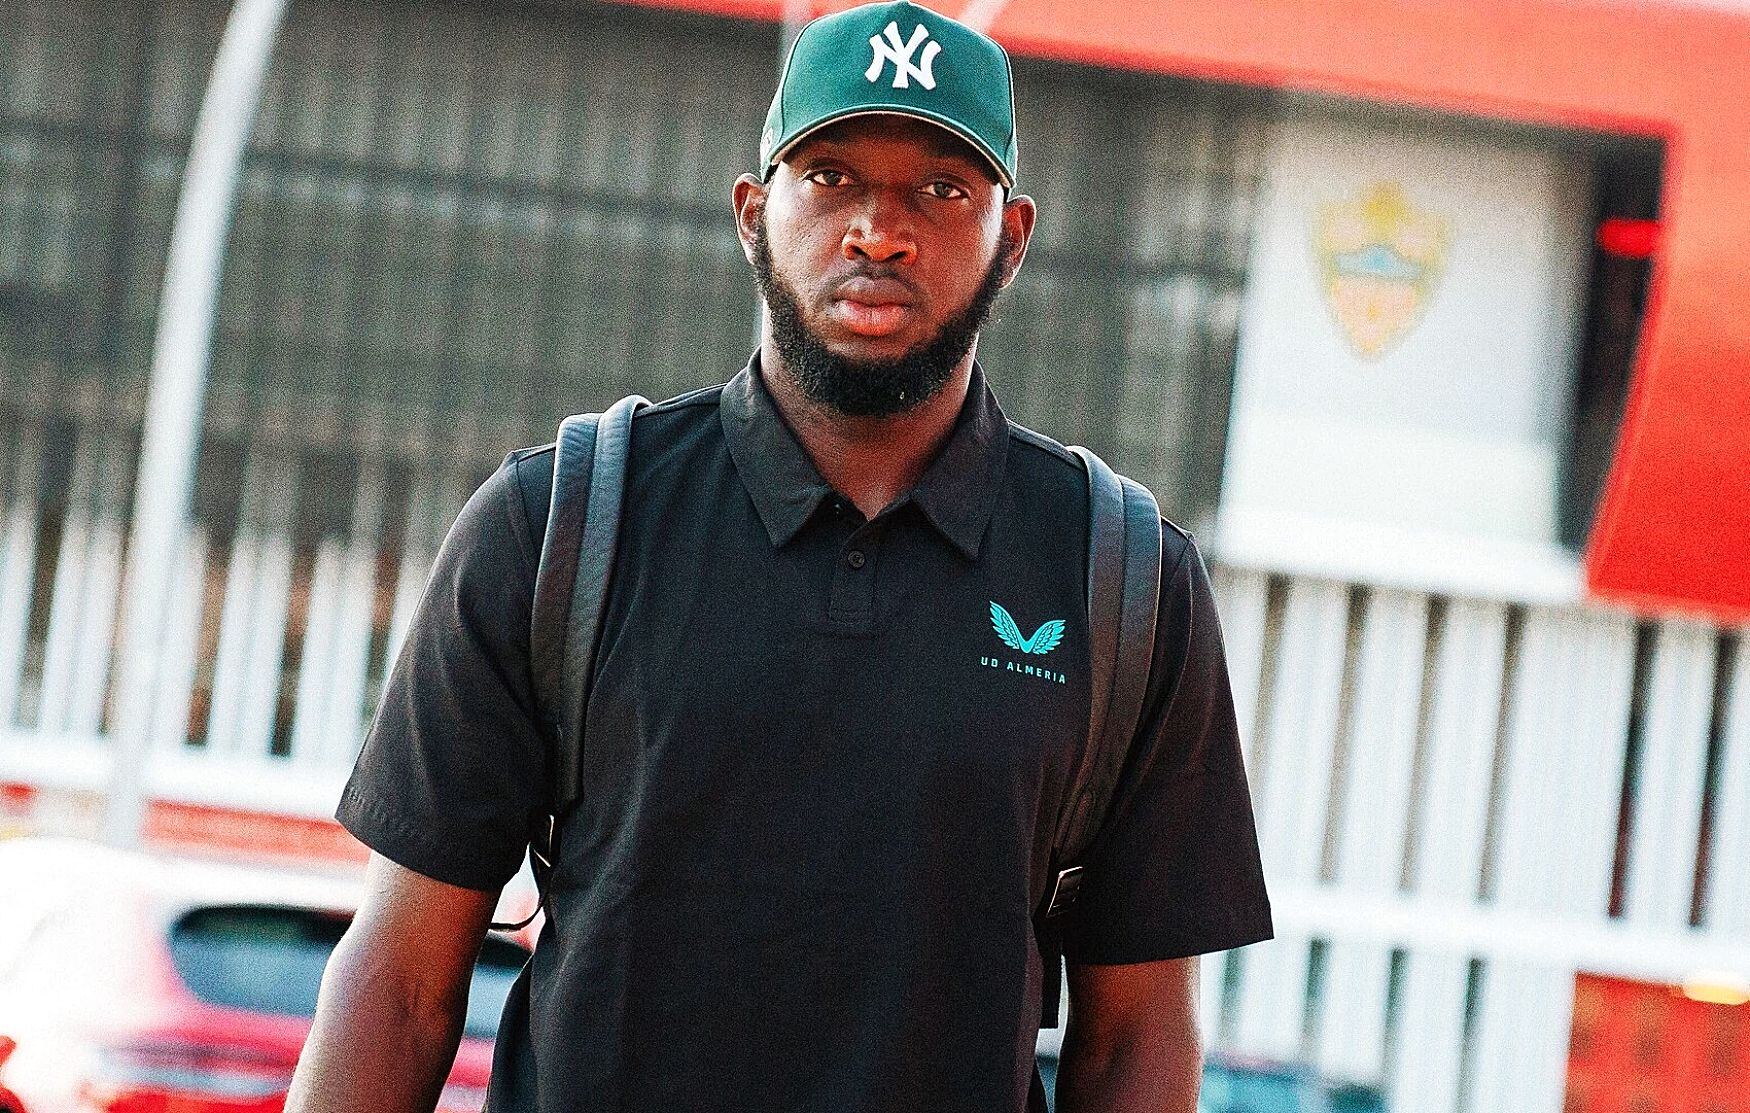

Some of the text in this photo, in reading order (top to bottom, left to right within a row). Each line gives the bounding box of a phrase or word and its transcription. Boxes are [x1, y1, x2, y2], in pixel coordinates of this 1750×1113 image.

[864, 20, 942, 91] NY
[980, 656, 1066, 684] UD ALMERIA
